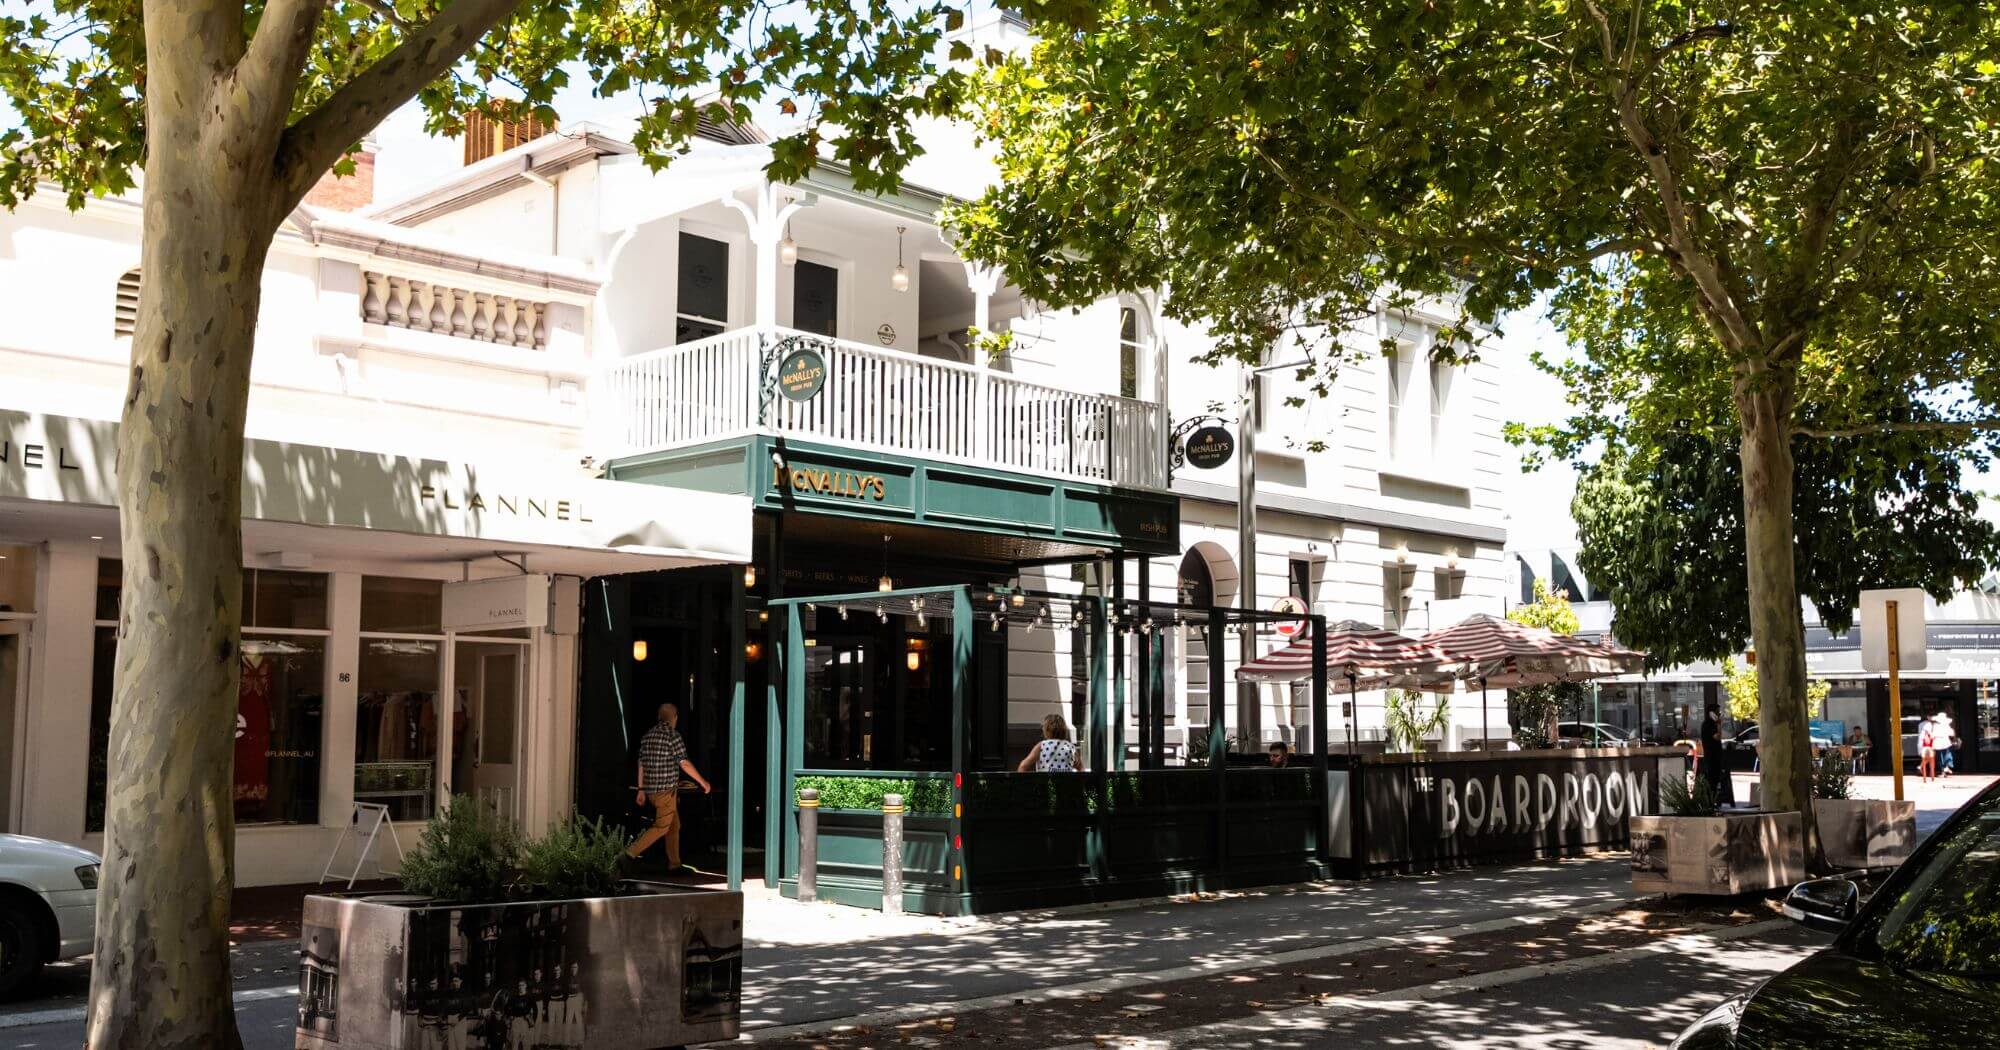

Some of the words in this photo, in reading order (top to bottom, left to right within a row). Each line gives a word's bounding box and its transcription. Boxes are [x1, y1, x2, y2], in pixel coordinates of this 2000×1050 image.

[783, 367, 821, 385] McNALLY'S
[421, 485, 593, 523] FLANNEL
[848, 575, 868, 584] WINES
[489, 608, 523, 618] FLANNEL
[339, 672, 351, 683] 86
[265, 750, 314, 759] @FLANNEL_AU
[1414, 776, 1435, 793] THE
[1440, 771, 1648, 833] BOARDROOM
